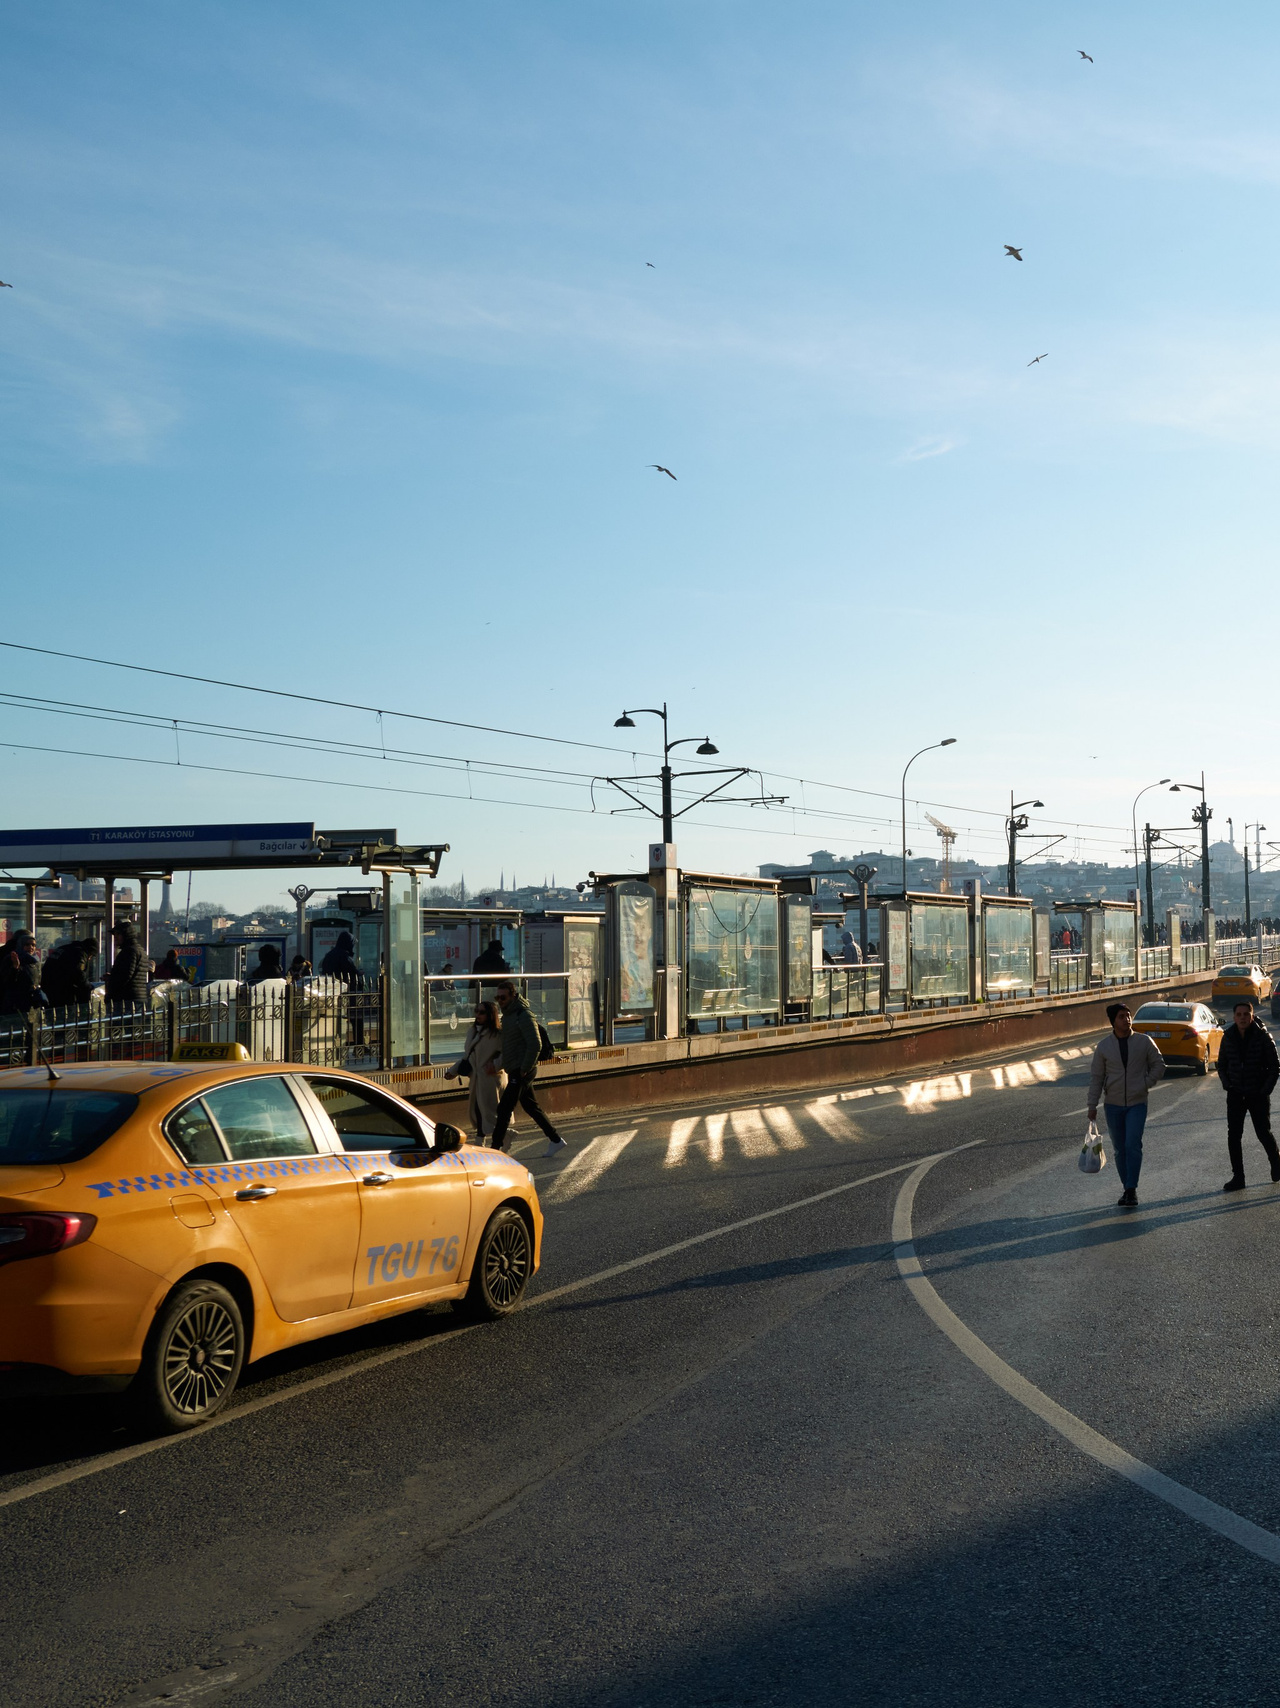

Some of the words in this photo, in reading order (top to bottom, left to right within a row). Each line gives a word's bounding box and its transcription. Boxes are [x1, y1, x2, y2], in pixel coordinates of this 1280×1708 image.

[90, 832, 100, 841] T1
[104, 829, 146, 840] KARAKÖY
[148, 828, 195, 839] İSTASYONU
[259, 841, 297, 852] Bağcılar
[366, 1240, 424, 1286] TGU
[428, 1235, 459, 1275] 76
